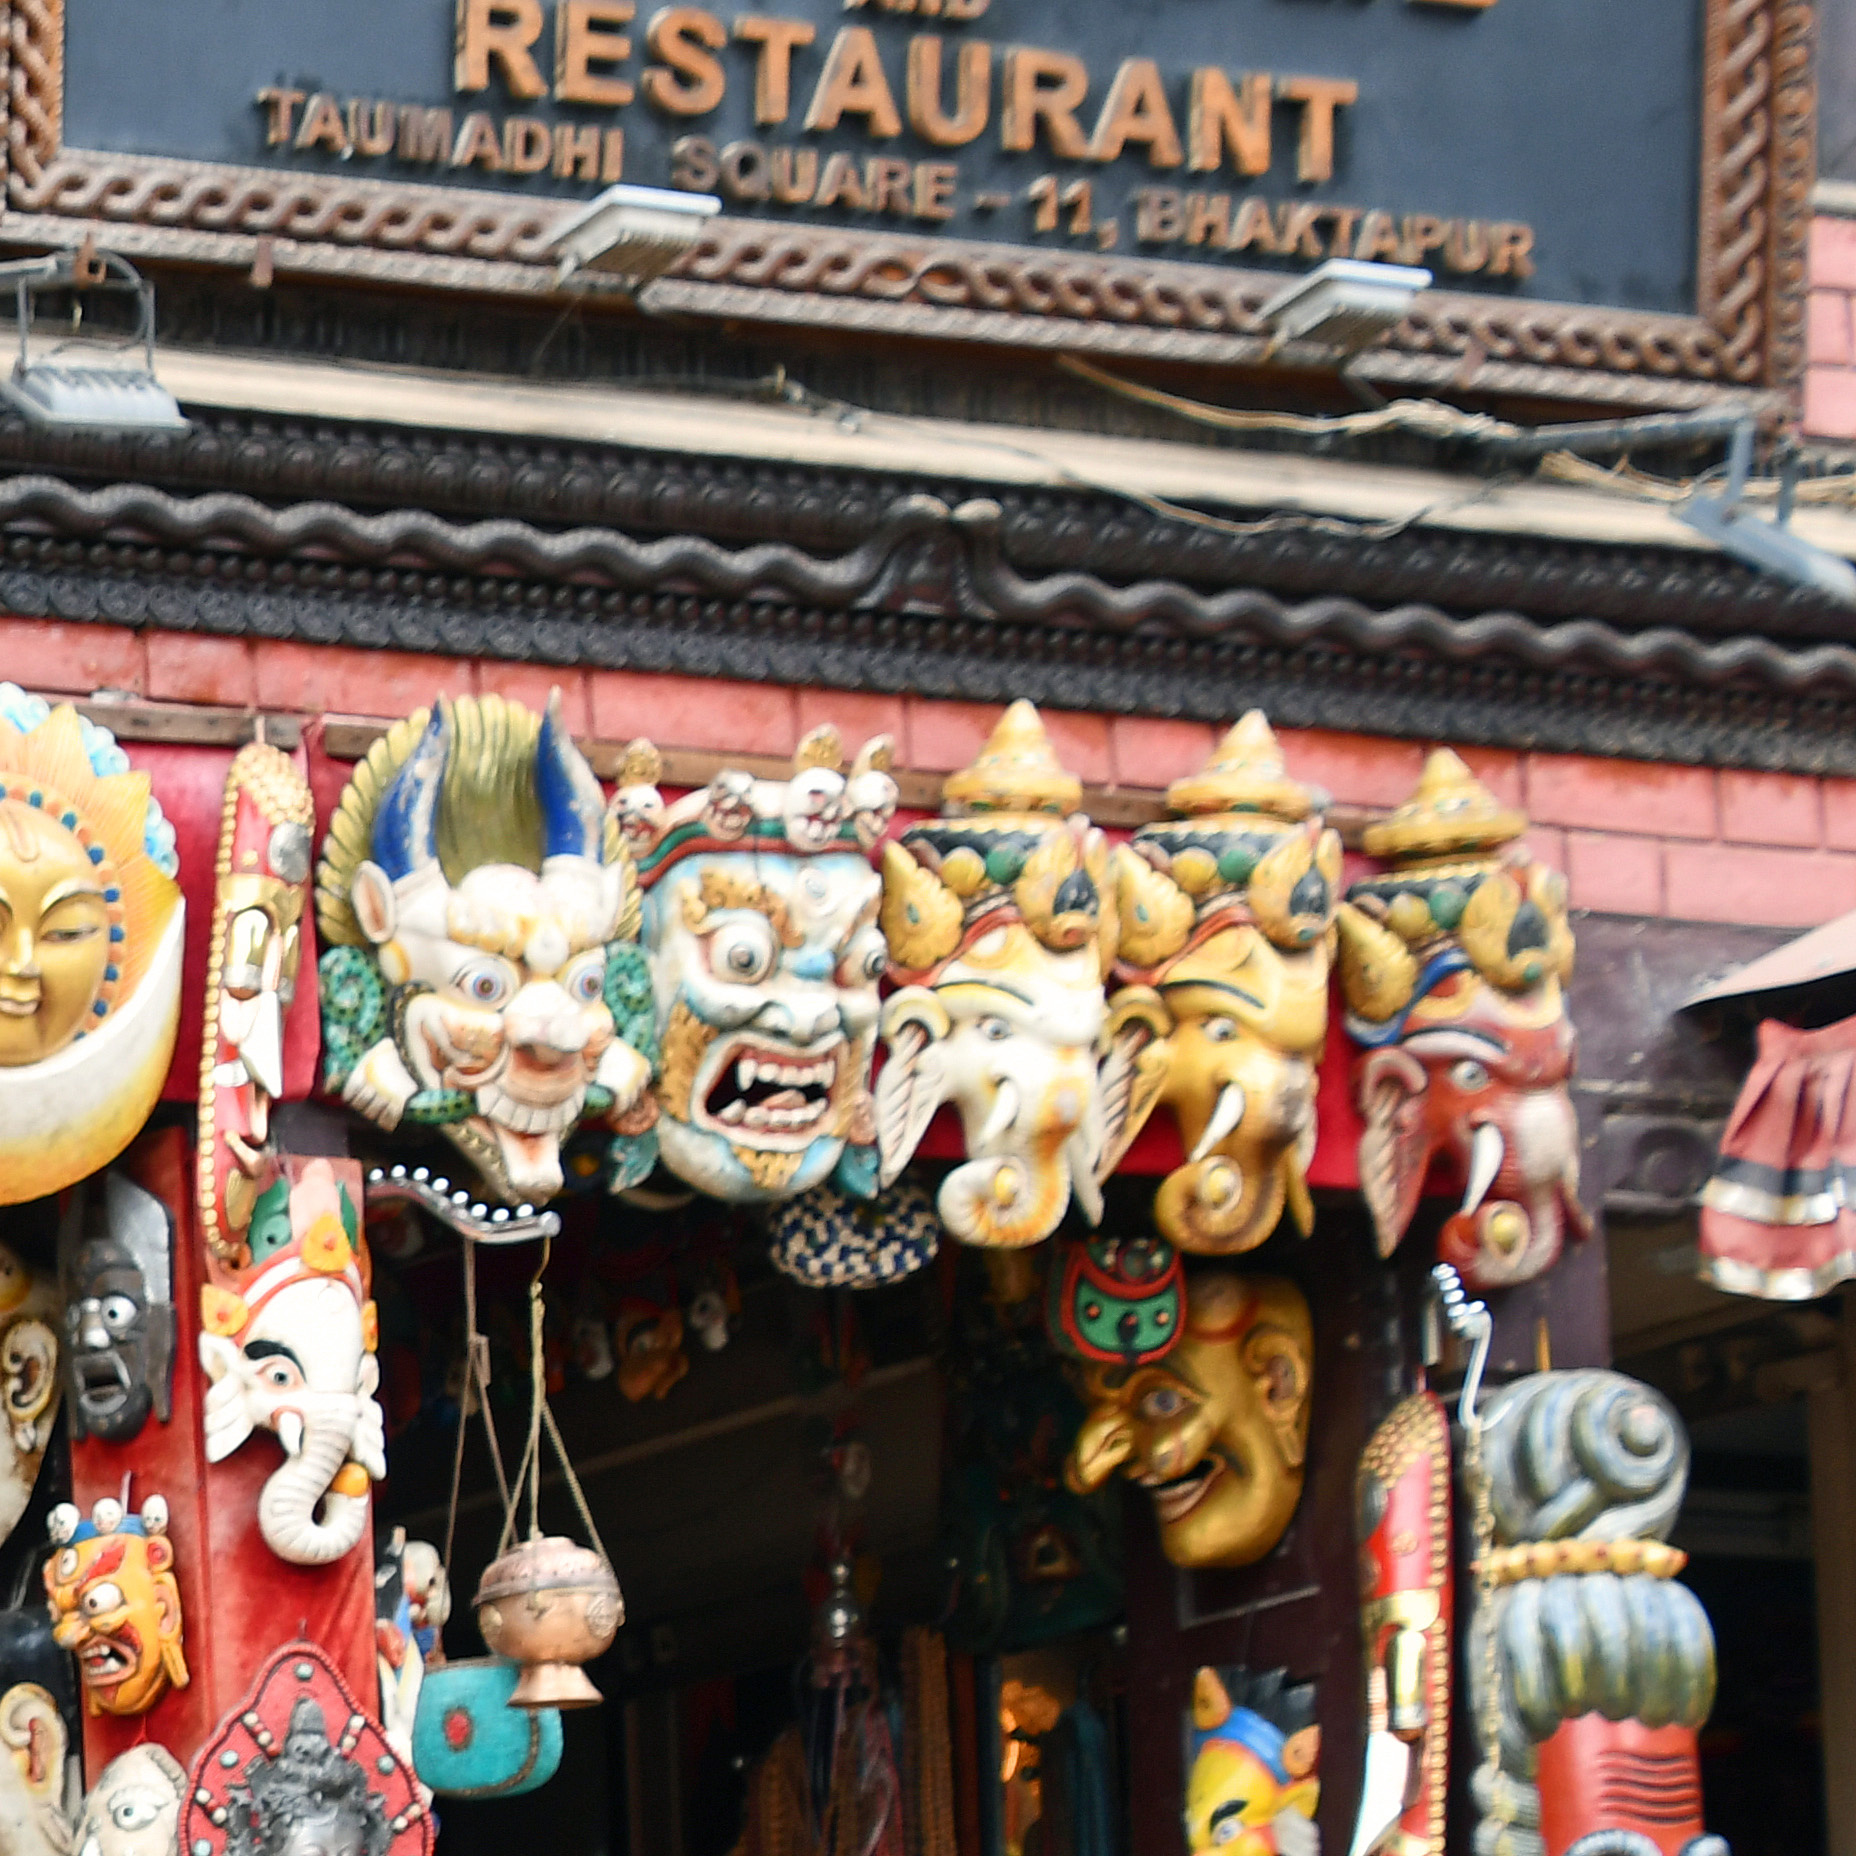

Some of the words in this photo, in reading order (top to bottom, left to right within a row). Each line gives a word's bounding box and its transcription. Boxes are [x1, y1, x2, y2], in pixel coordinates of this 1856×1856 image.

[257, 87, 624, 184] TAUMADHI
[671, 134, 959, 220] SQUARE
[1135, 186, 1536, 279] BHAKTAPUR
[452, 0, 1359, 185] RESTAURANT
